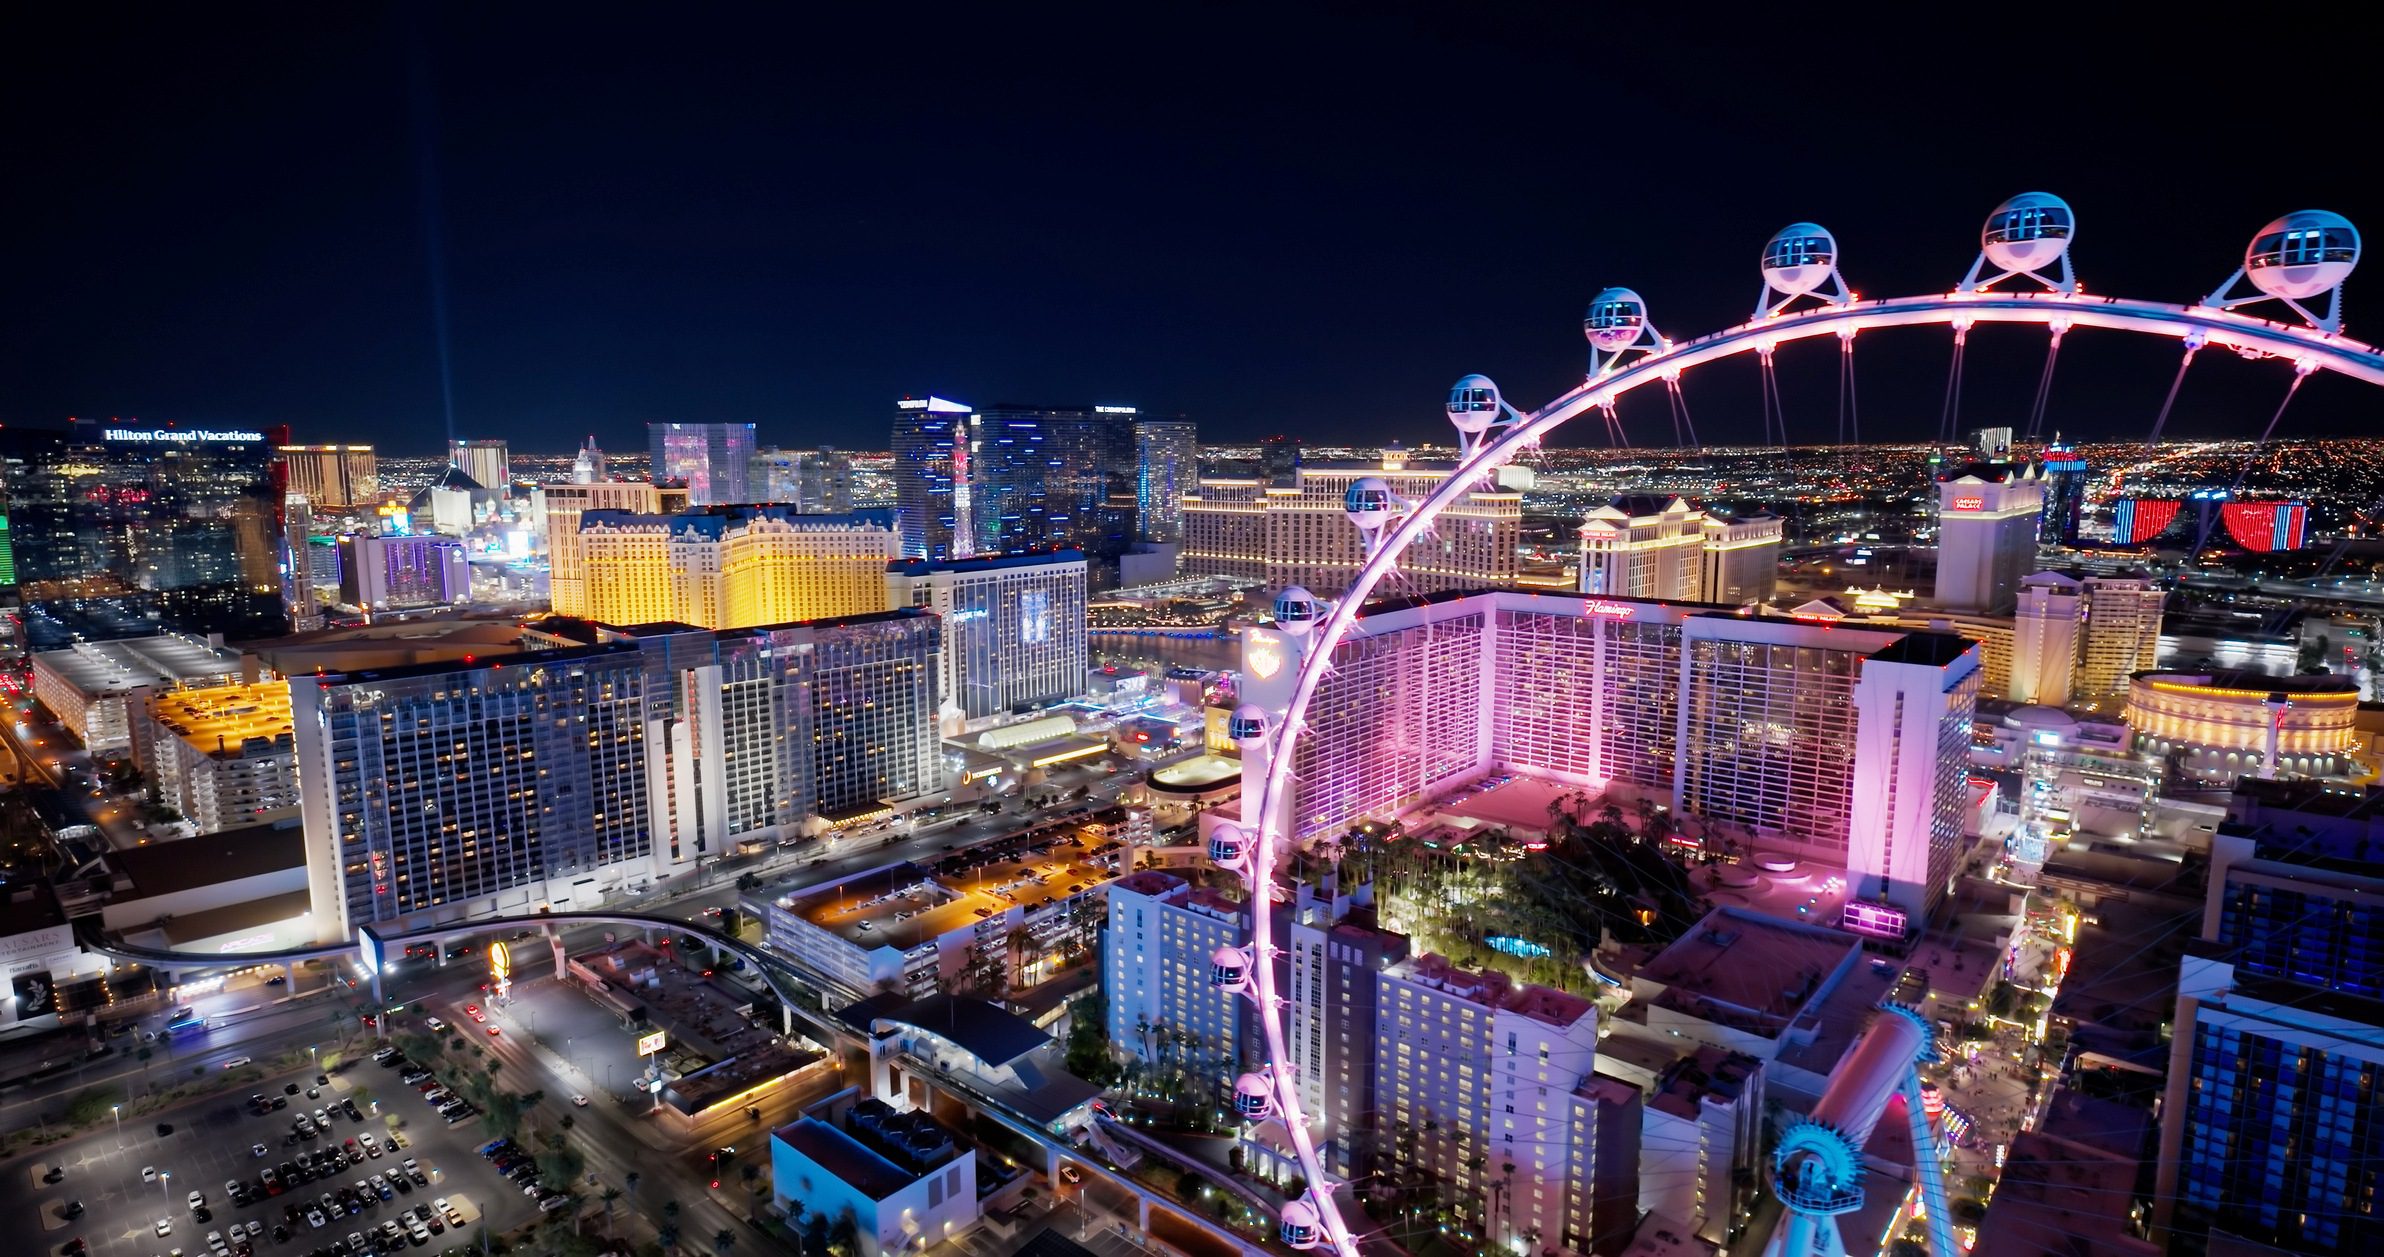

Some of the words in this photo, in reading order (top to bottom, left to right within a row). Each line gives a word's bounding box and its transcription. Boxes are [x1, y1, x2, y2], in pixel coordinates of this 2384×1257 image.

[105, 430, 152, 441] Hilton
[154, 430, 197, 441] Grand
[198, 430, 263, 442] Vacations
[1585, 600, 1635, 619] Flamingo
